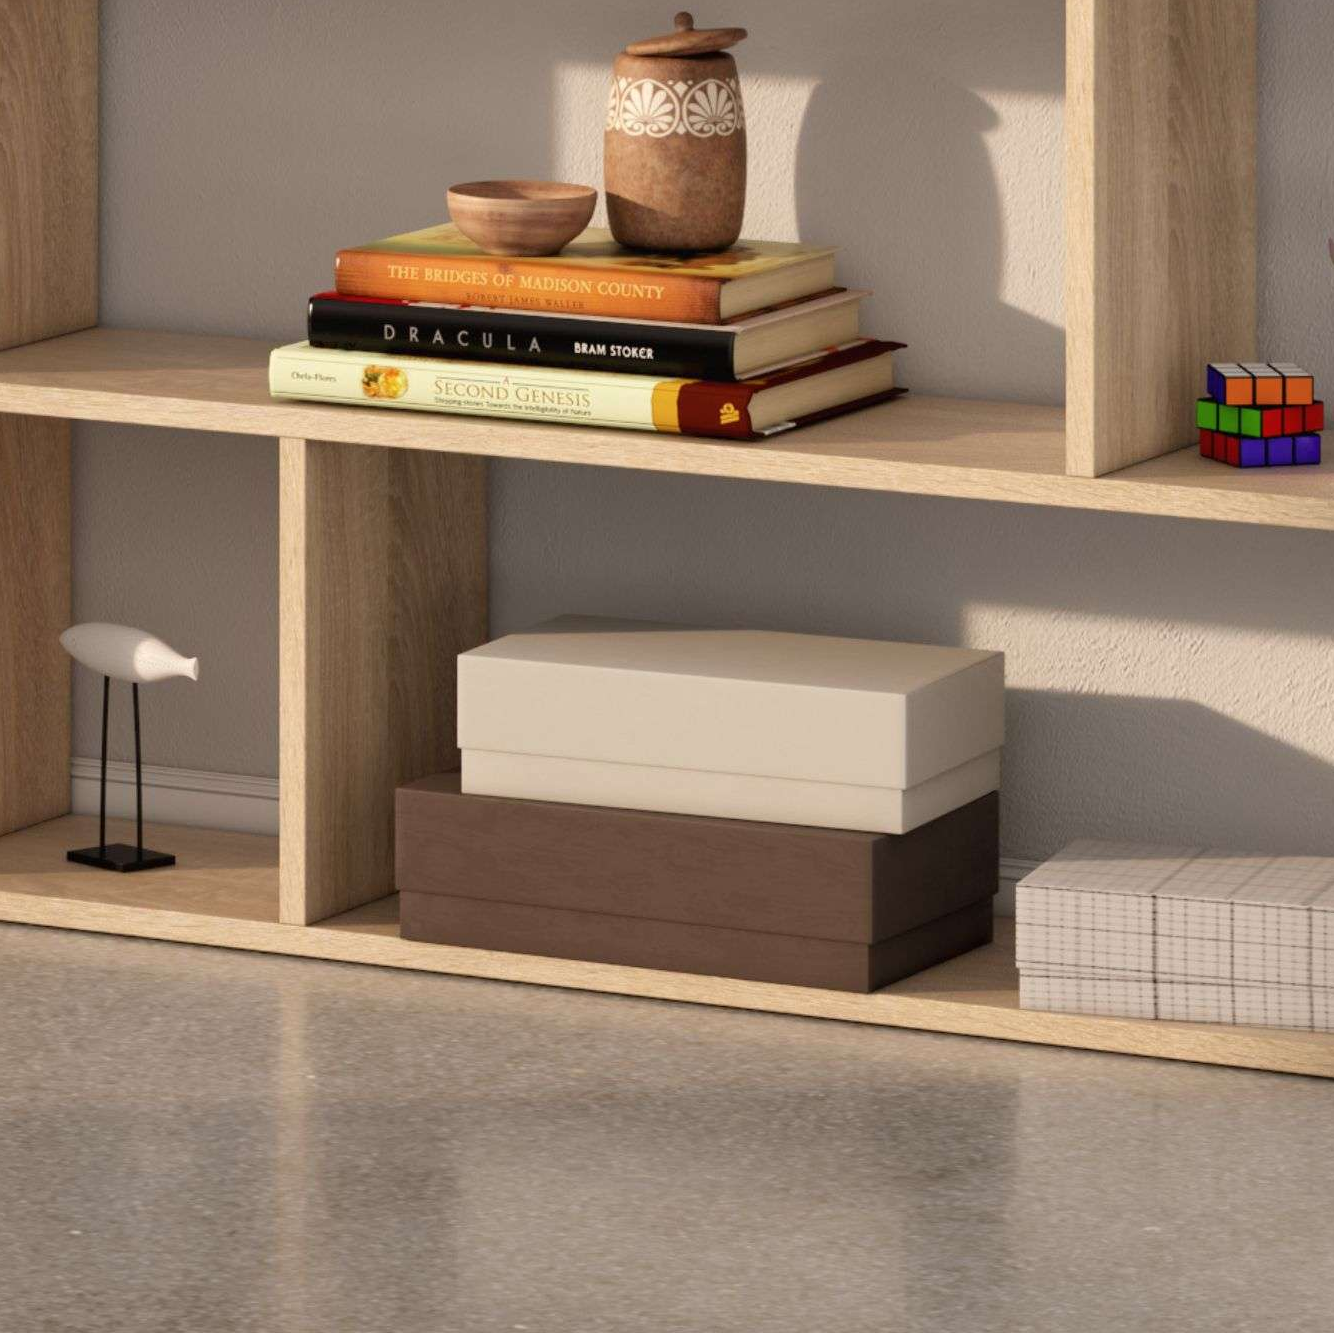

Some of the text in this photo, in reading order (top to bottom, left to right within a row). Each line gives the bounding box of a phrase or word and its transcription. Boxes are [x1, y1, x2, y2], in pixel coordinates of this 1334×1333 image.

[387, 264, 665, 300] THE BRIDGES OF MADISON COUNTY
[383, 324, 655, 360] DRACULA BRAM STOKER
[434, 379, 591, 408] SECOND GENESIS
